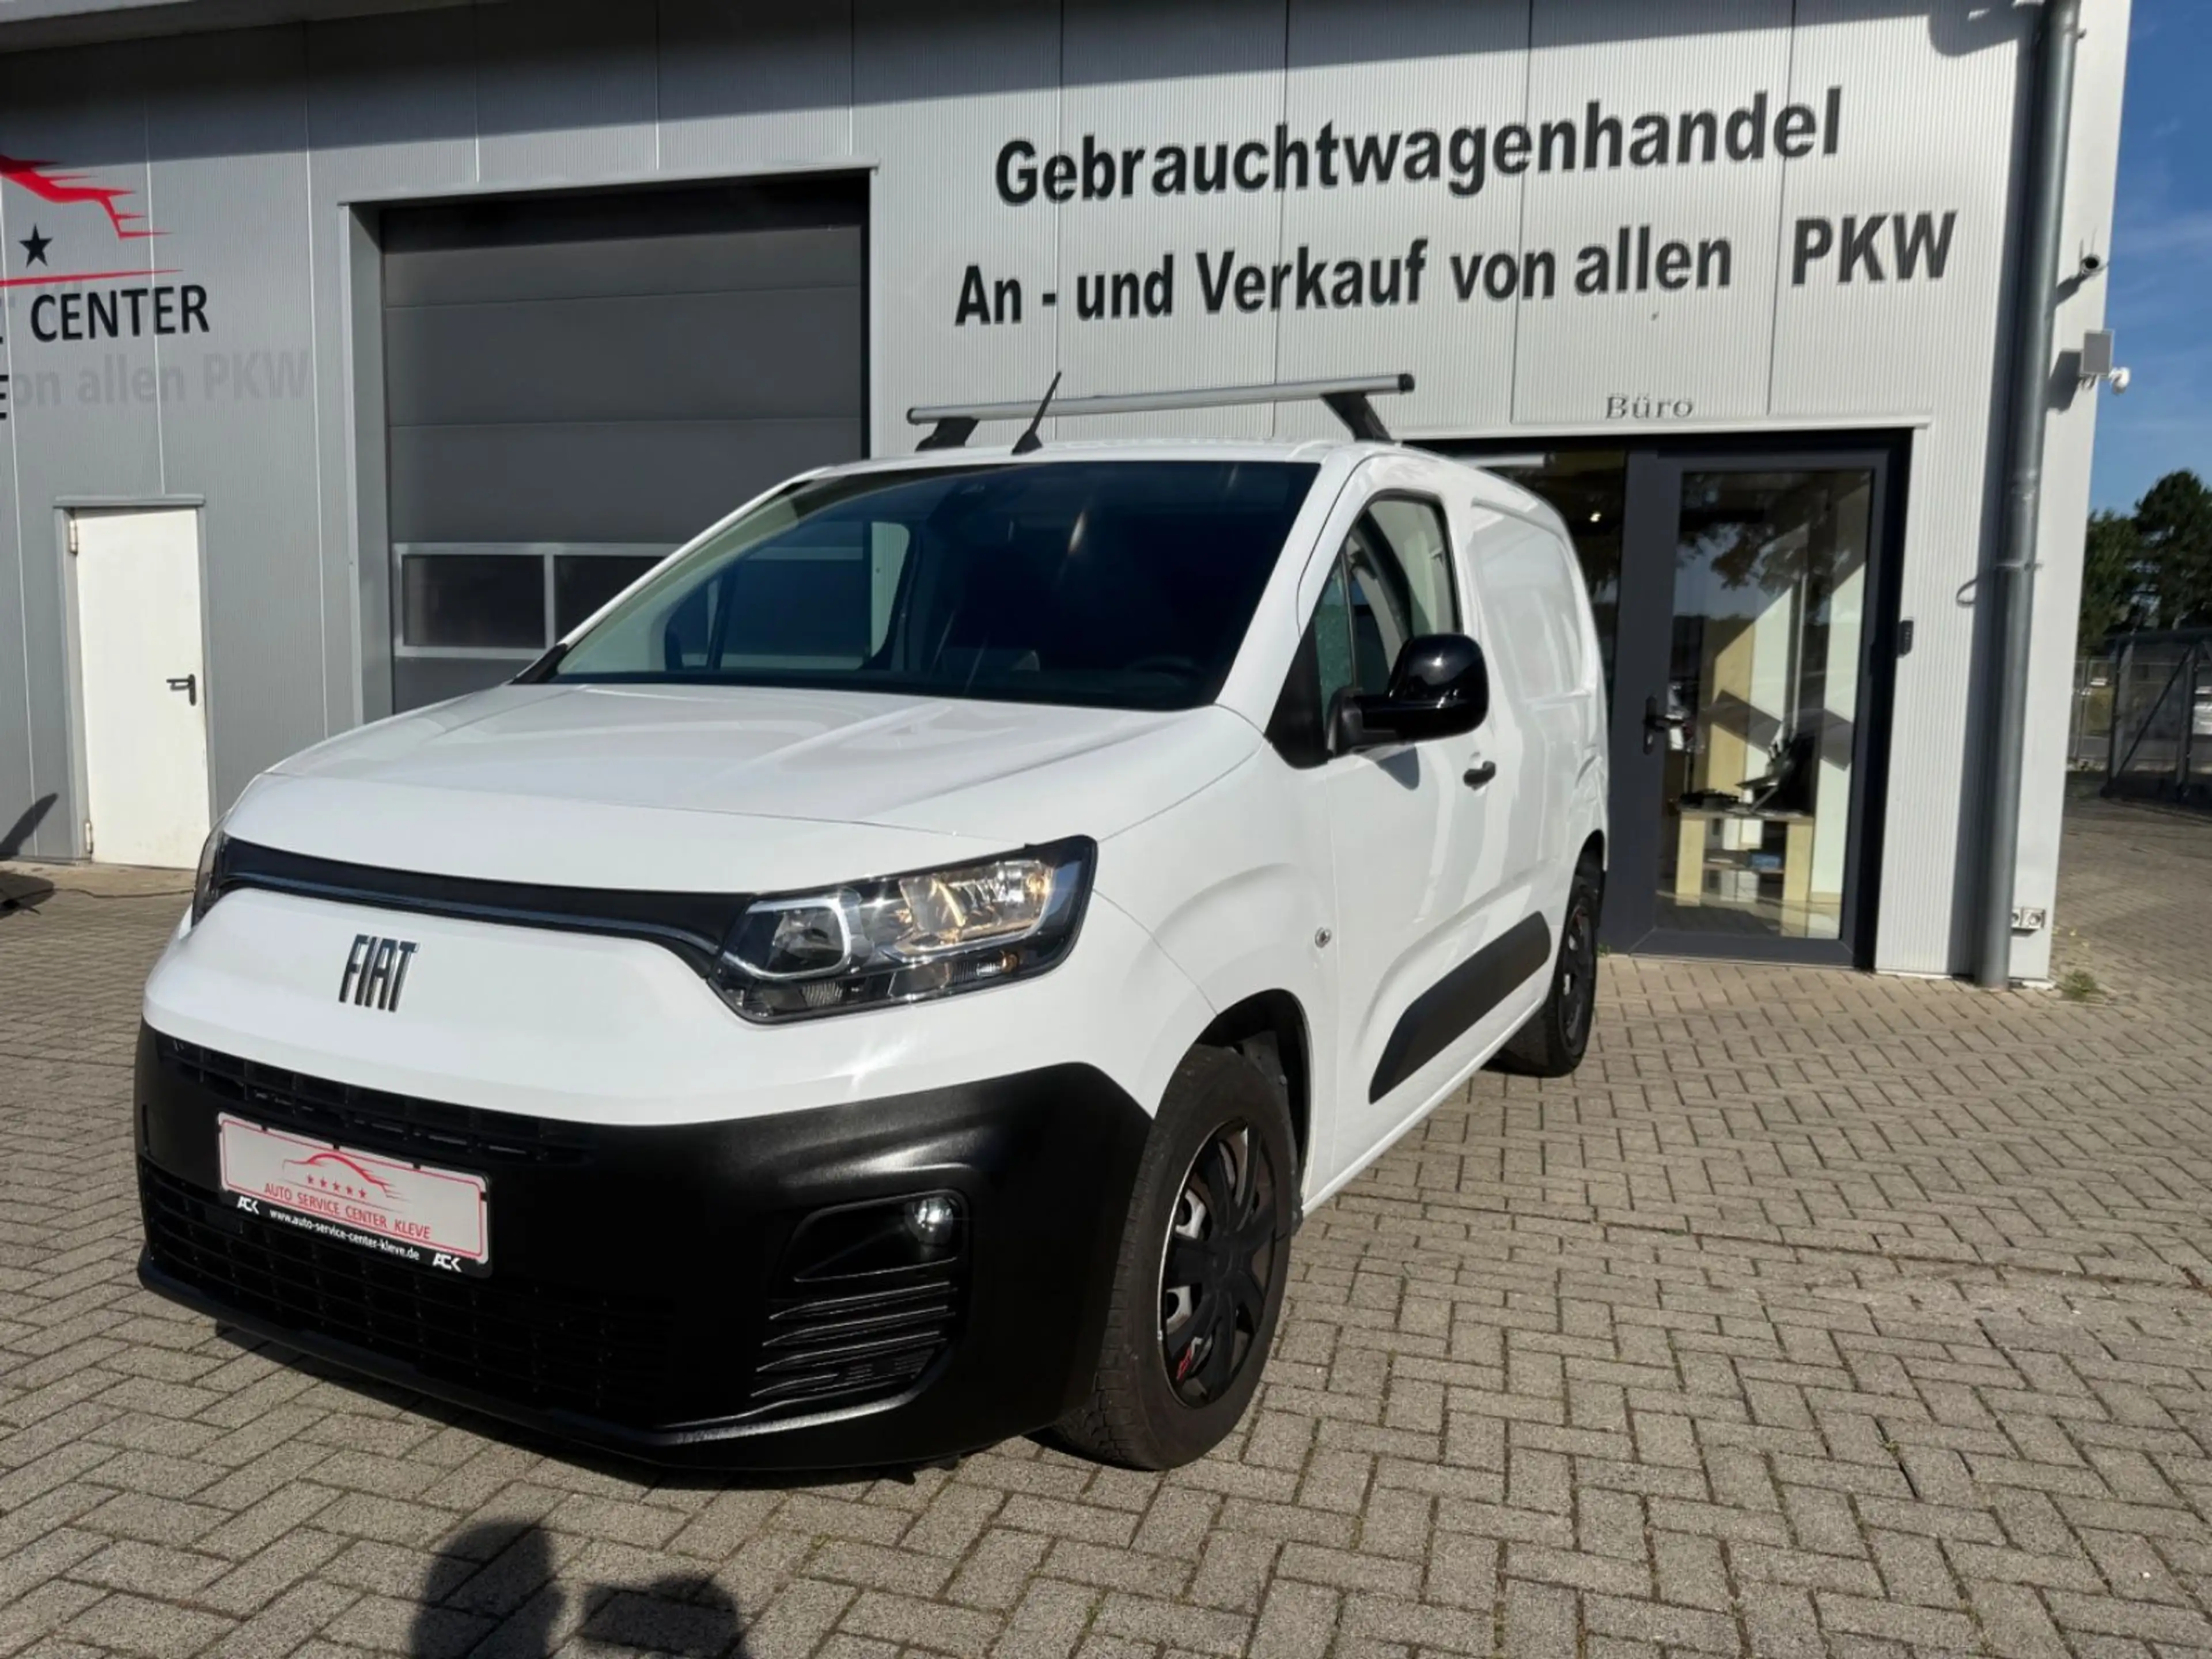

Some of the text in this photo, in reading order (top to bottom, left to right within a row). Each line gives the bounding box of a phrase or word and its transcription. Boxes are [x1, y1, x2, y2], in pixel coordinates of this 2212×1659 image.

[996, 85, 1842, 205] Gebrauchtwagenhandel
[955, 264, 1022, 326] An
[1076, 254, 1173, 320] und
[1196, 238, 1429, 313] Verkauf
[1450, 248, 1555, 301] von
[1575, 225, 1732, 296] allen
[1791, 209, 1959, 287] PKW
[31, 284, 210, 342] CENTER
[203, 349, 309, 402] PKW
[1605, 392, 1694, 420] Büro
[339, 933, 421, 1013] FIAT
[264, 1183, 431, 1239] AUTO SERVICE CENTER KLEVE
[269, 1209, 420, 1260] www.auto-service-center-kleve.de
